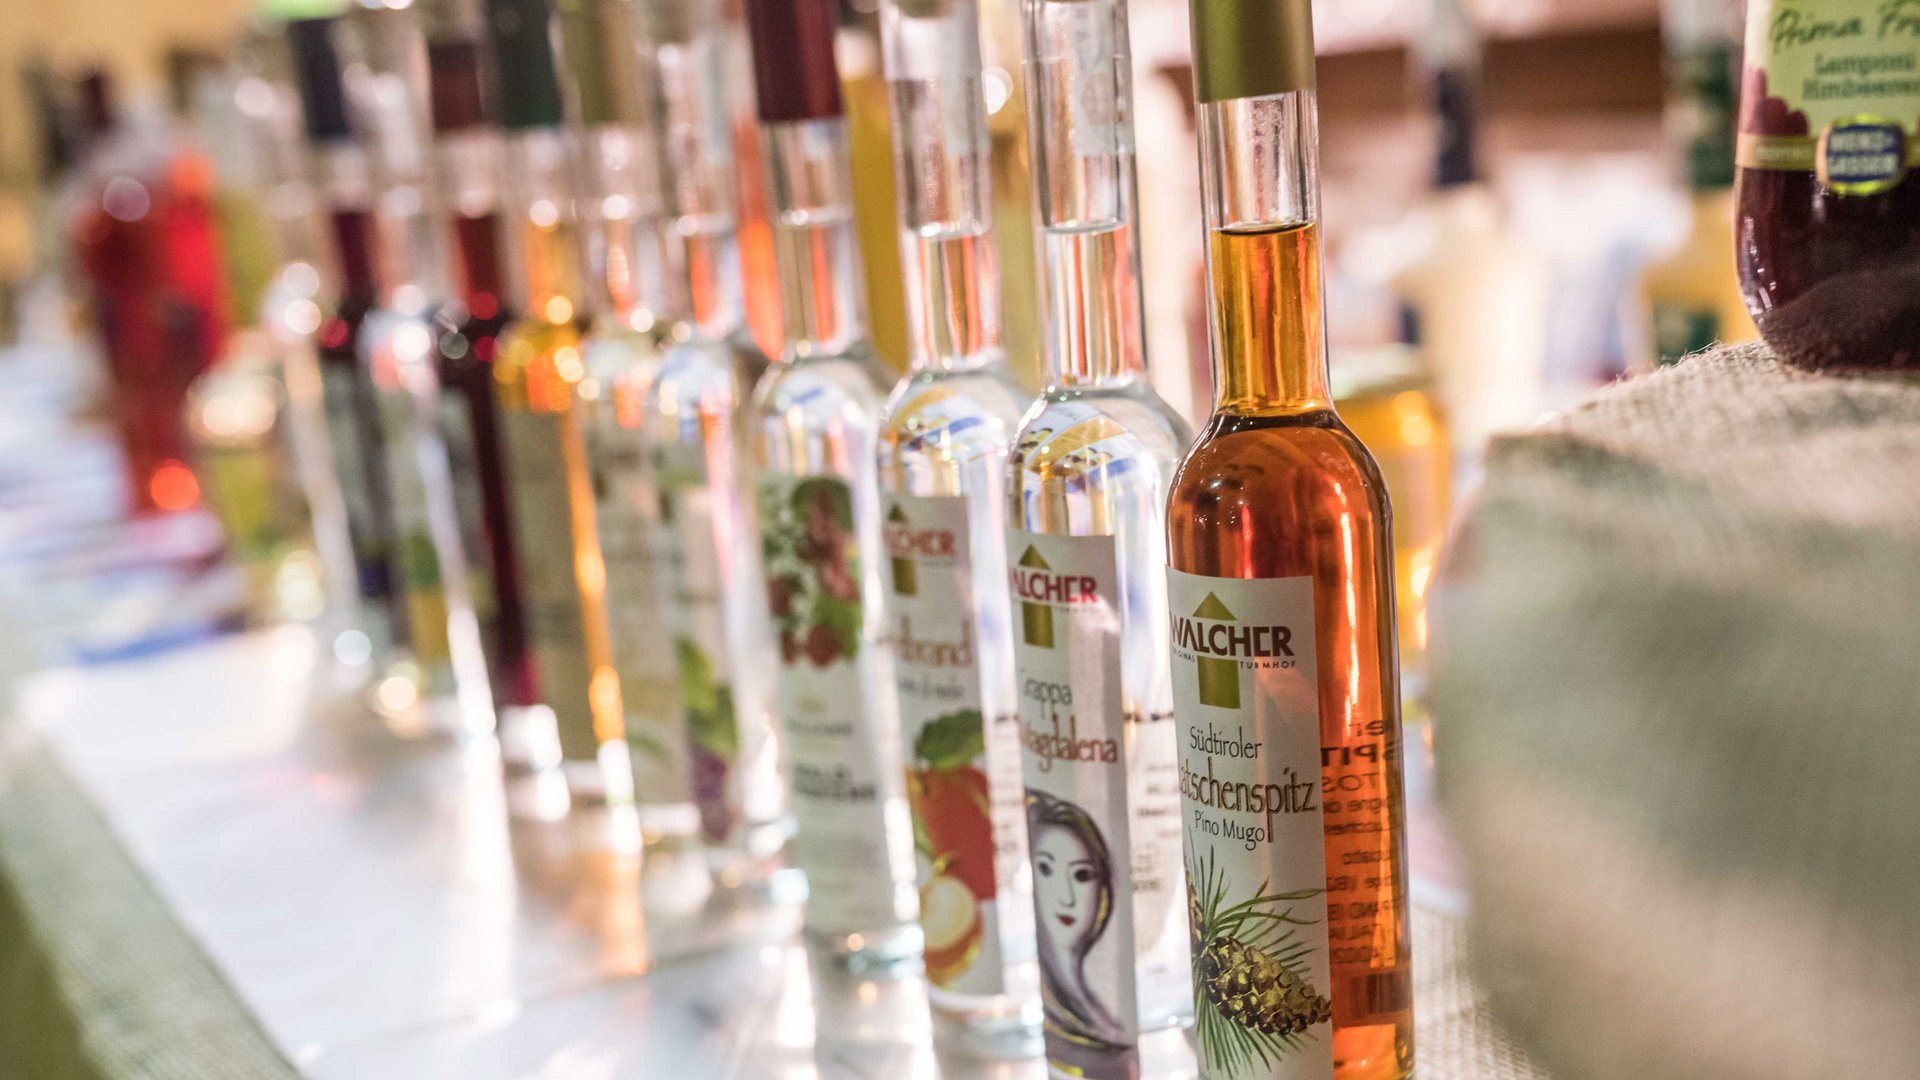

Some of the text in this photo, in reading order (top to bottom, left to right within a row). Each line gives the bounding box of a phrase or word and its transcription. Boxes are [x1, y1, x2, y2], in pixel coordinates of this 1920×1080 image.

[1169, 611, 1295, 657] WALCHER
[1240, 660, 1297, 669] TURMHOF
[1189, 722, 1263, 760] Südtiroler
[1179, 757, 1320, 843] atschenspitz
[1194, 810, 1266, 851] Pino Mugo
